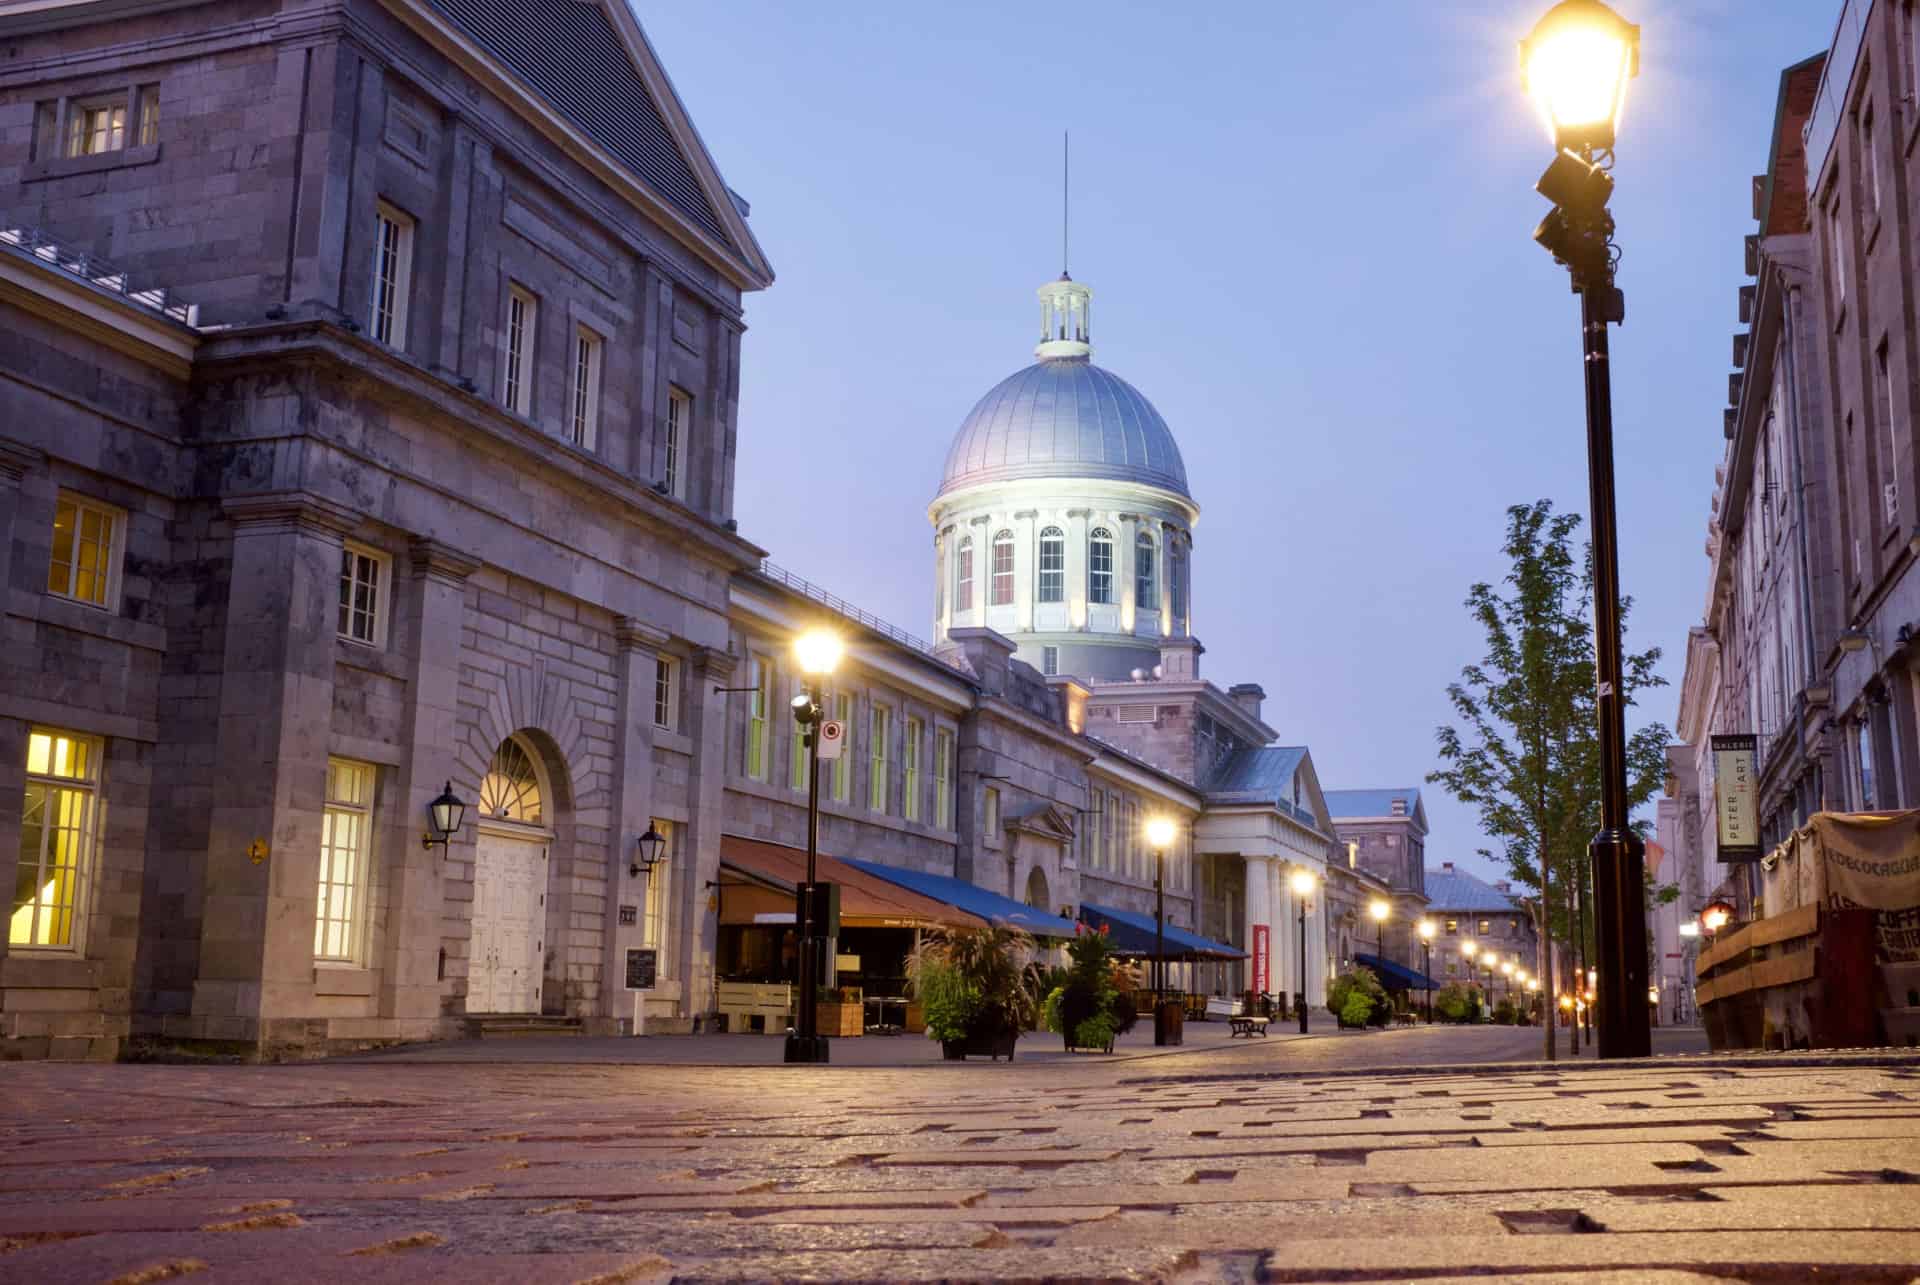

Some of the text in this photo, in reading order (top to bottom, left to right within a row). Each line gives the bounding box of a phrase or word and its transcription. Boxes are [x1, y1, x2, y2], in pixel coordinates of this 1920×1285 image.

[1713, 741, 1753, 750] GALERIE
[1736, 758, 1745, 792] HART
[1728, 796, 1739, 839] PETER
